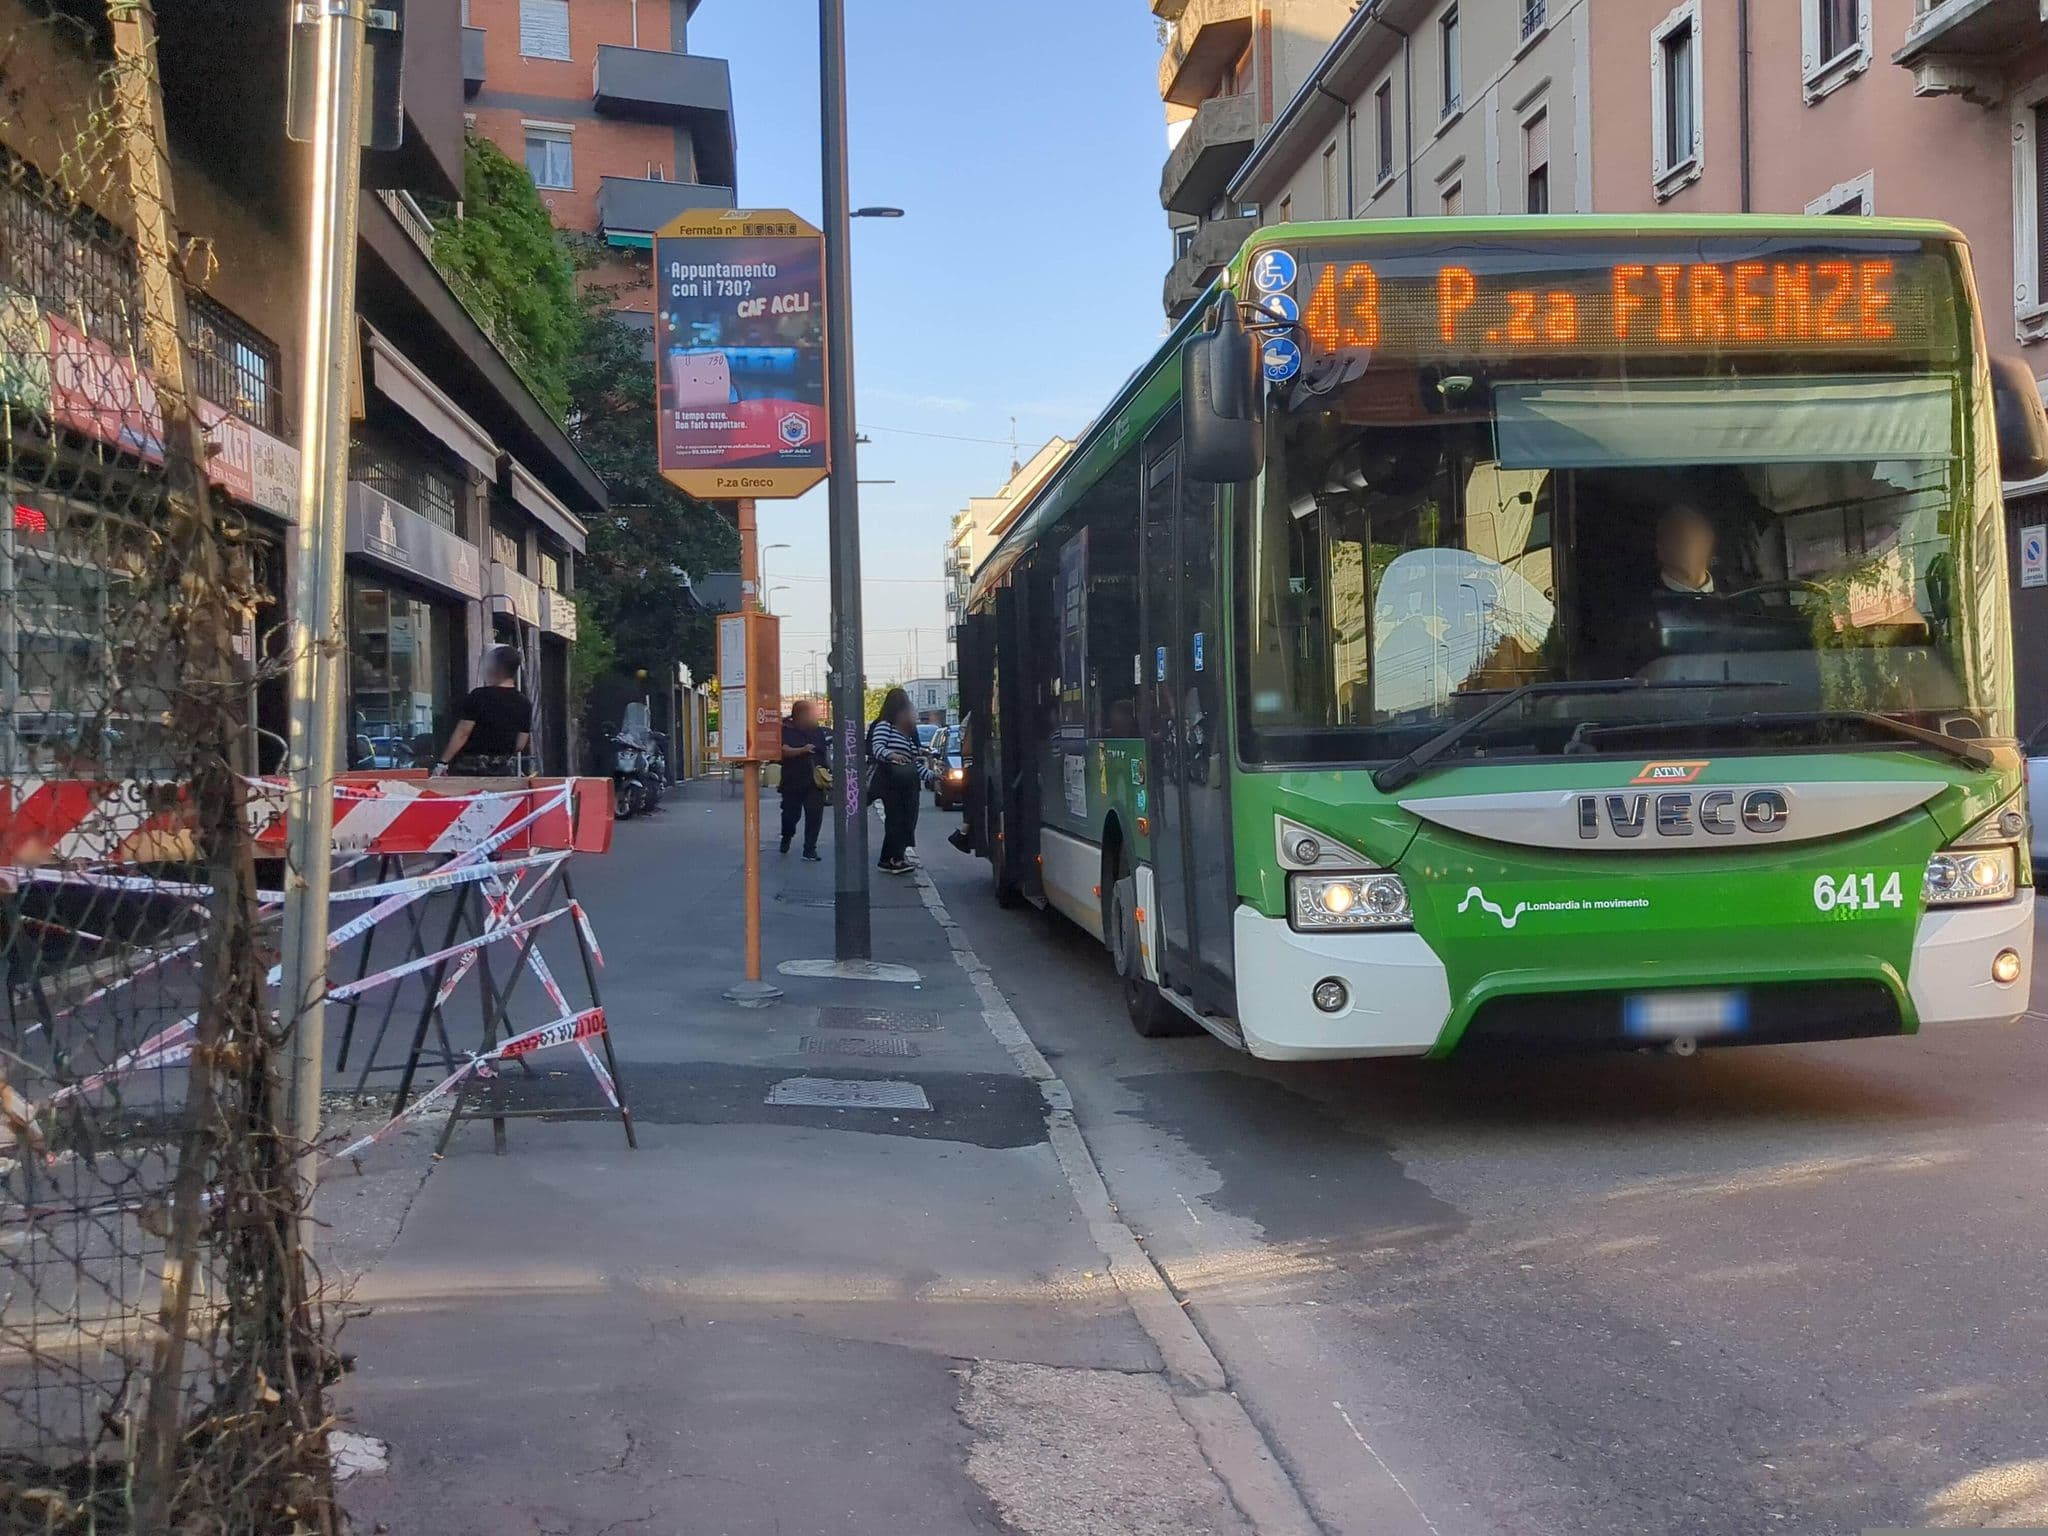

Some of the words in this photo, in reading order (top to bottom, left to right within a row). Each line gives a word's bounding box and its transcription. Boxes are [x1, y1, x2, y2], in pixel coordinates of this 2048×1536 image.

[680, 225, 722, 236] Fermata
[671, 261, 777, 281] Appuntamento
[672, 283, 699, 297] con
[703, 280, 712, 297] il
[717, 279, 752, 297] 730?
[737, 297, 768, 319] CAF
[771, 292, 810, 315] ACLI
[1303, 262, 1381, 352] 43
[1611, 260, 1894, 342] FIRENZE
[682, 411, 704, 422] tempo
[706, 412, 728, 420] corre.
[690, 420, 709, 430] farlo
[710, 420, 748, 431] aspettare.
[717, 478, 738, 488] P.za
[741, 478, 774, 488] Greco
[1652, 765, 1687, 779] ATM
[1577, 788, 1790, 840] IVECO
[1812, 871, 1904, 912] 6414
[1526, 899, 1581, 911] Lombardia
[1582, 899, 1593, 910] in
[1594, 897, 1650, 910] movimento
